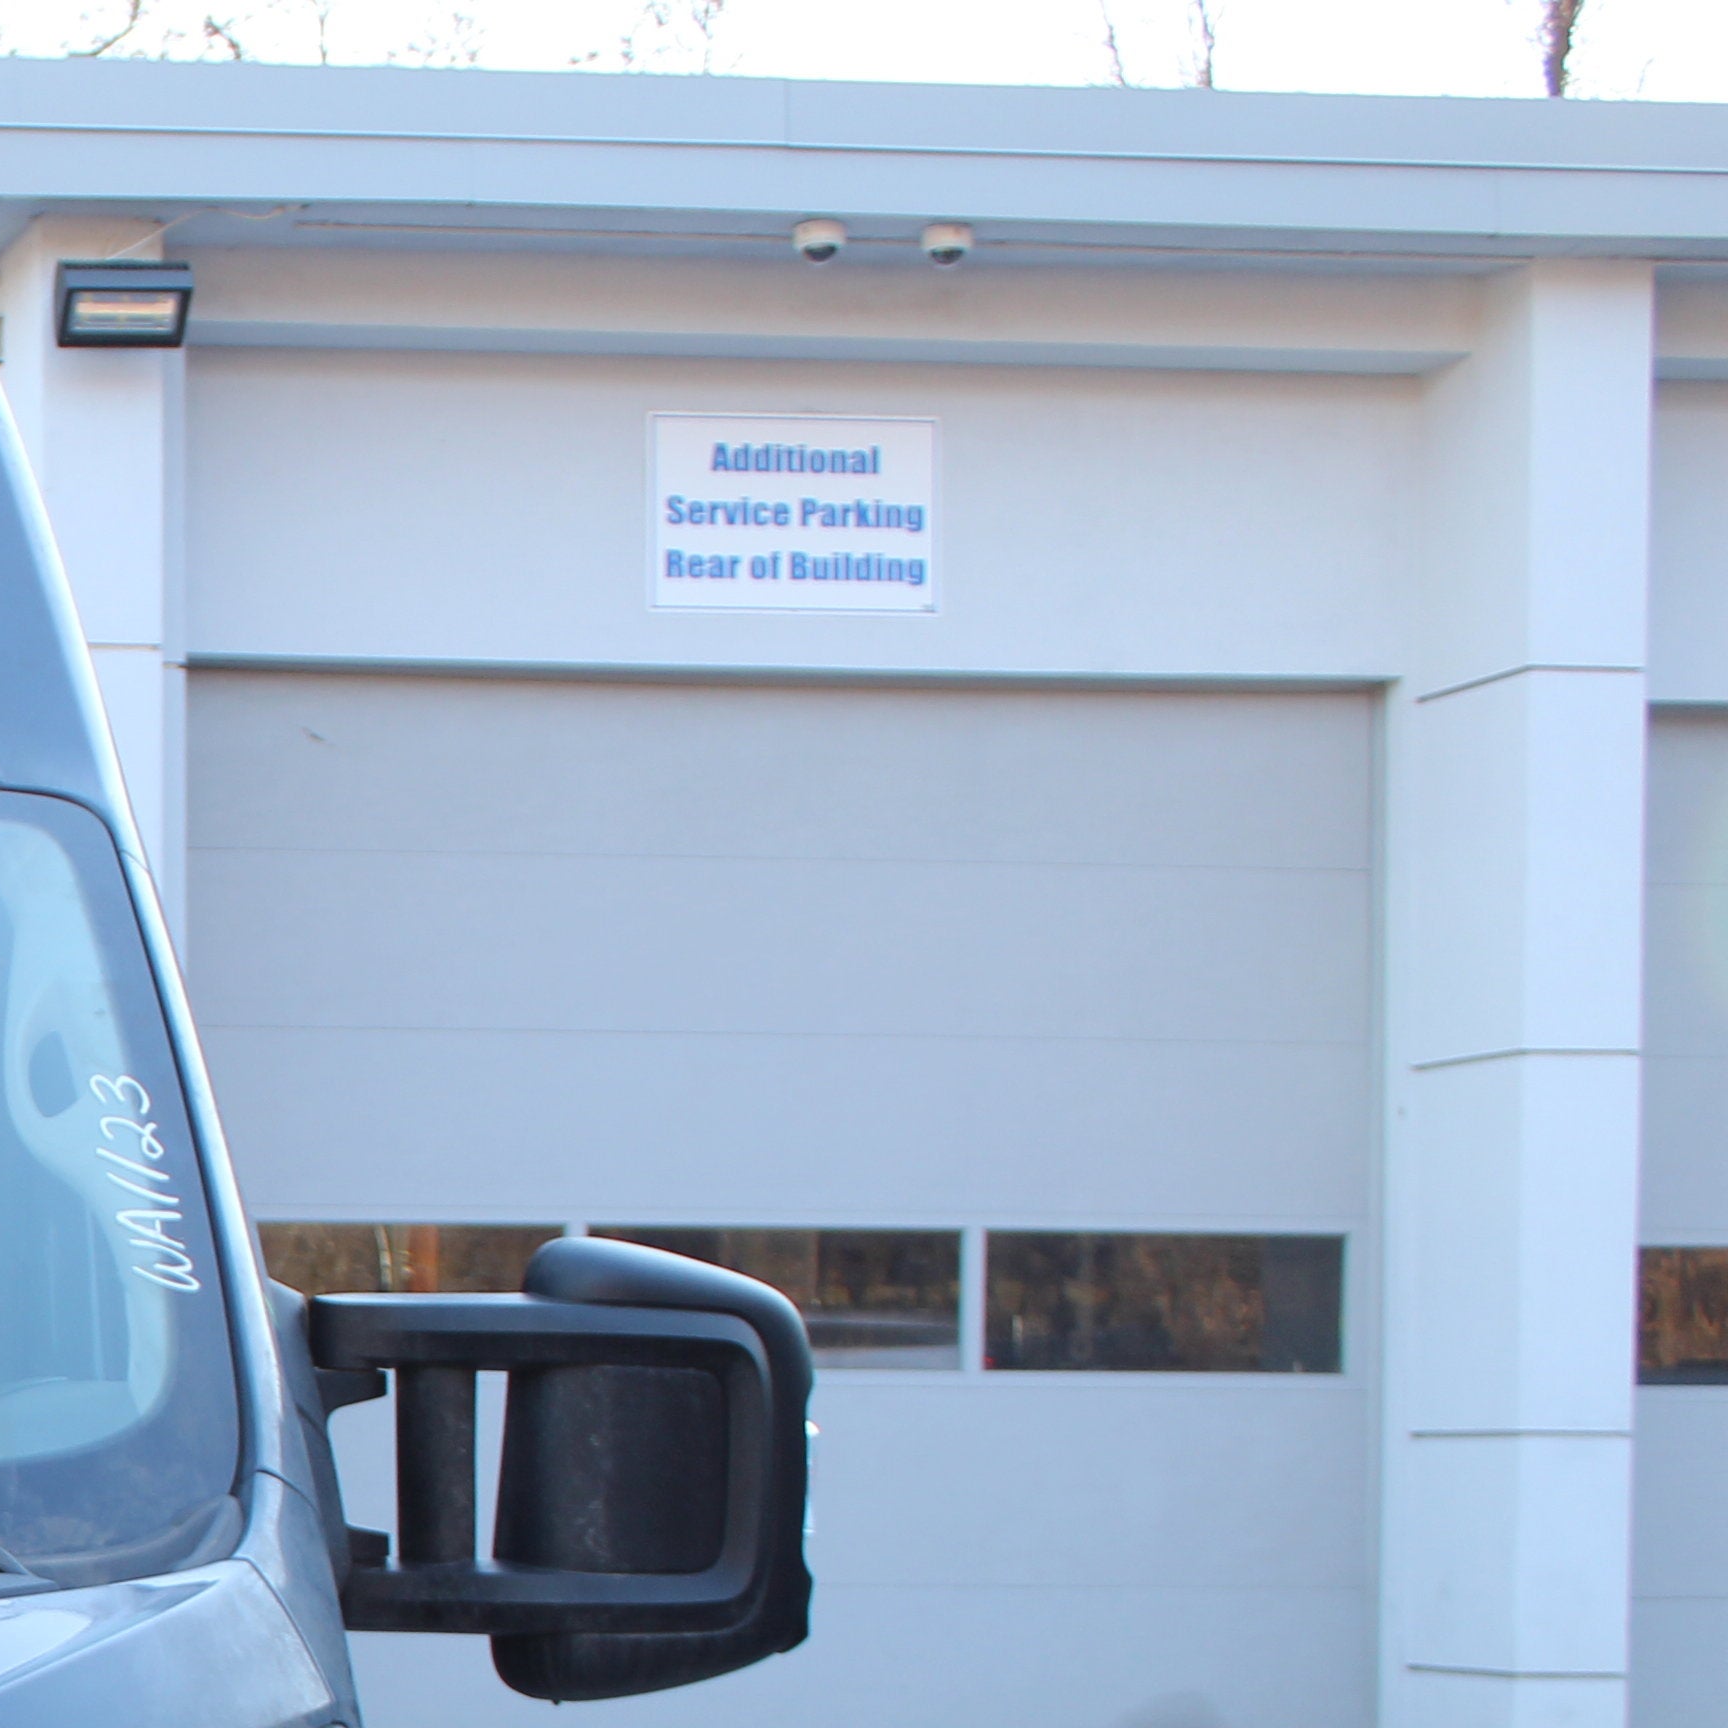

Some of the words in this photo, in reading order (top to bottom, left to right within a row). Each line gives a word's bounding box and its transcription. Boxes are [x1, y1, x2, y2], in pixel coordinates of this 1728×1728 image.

[710, 442, 881, 475] Additional
[665, 495, 791, 526] Service
[799, 497, 926, 533] Parking
[665, 548, 742, 580] Rear
[750, 551, 781, 580] of
[789, 551, 927, 586] Building
